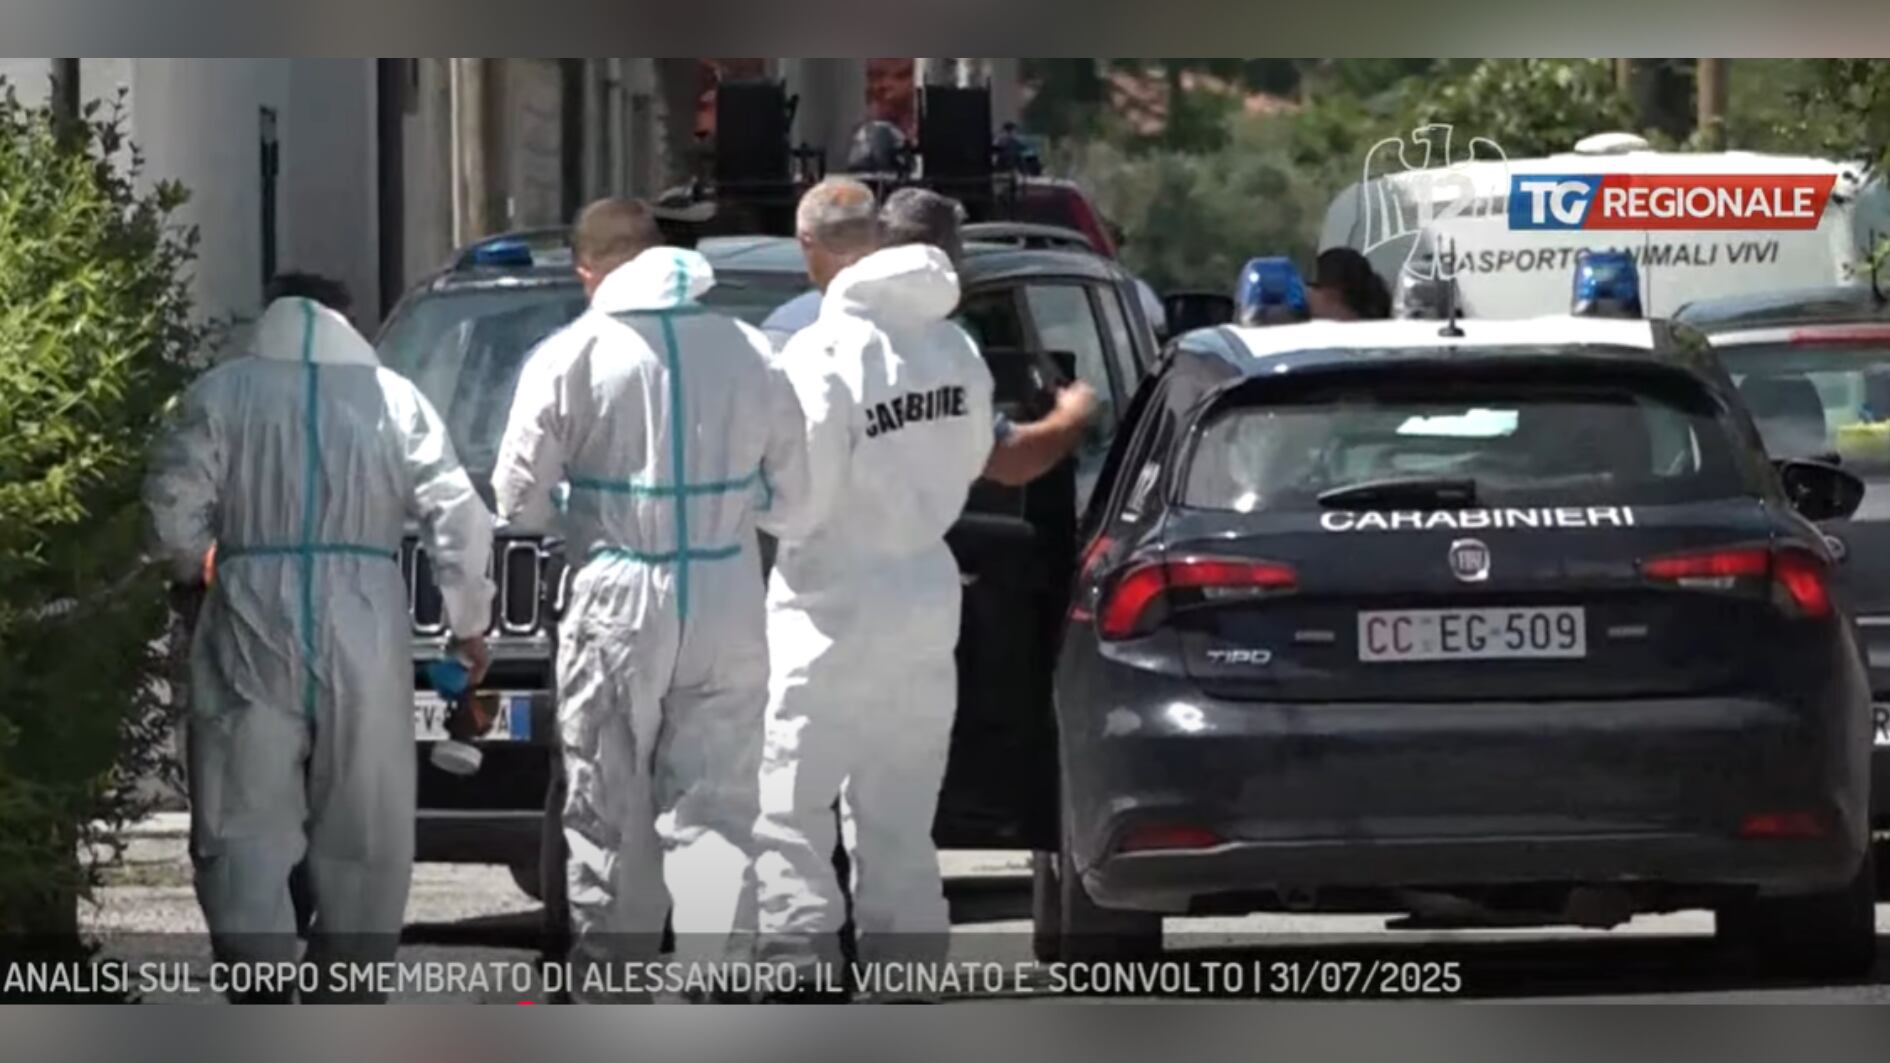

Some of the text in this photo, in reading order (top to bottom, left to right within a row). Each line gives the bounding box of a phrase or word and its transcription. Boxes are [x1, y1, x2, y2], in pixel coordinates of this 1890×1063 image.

[1608, 243, 1718, 267] NIMALI
[1726, 240, 1780, 264] VIVI
[1320, 506, 1636, 532] CARABINIERI
[1366, 613, 1577, 655] CC EG 509
[1206, 650, 1272, 665] TIPO
